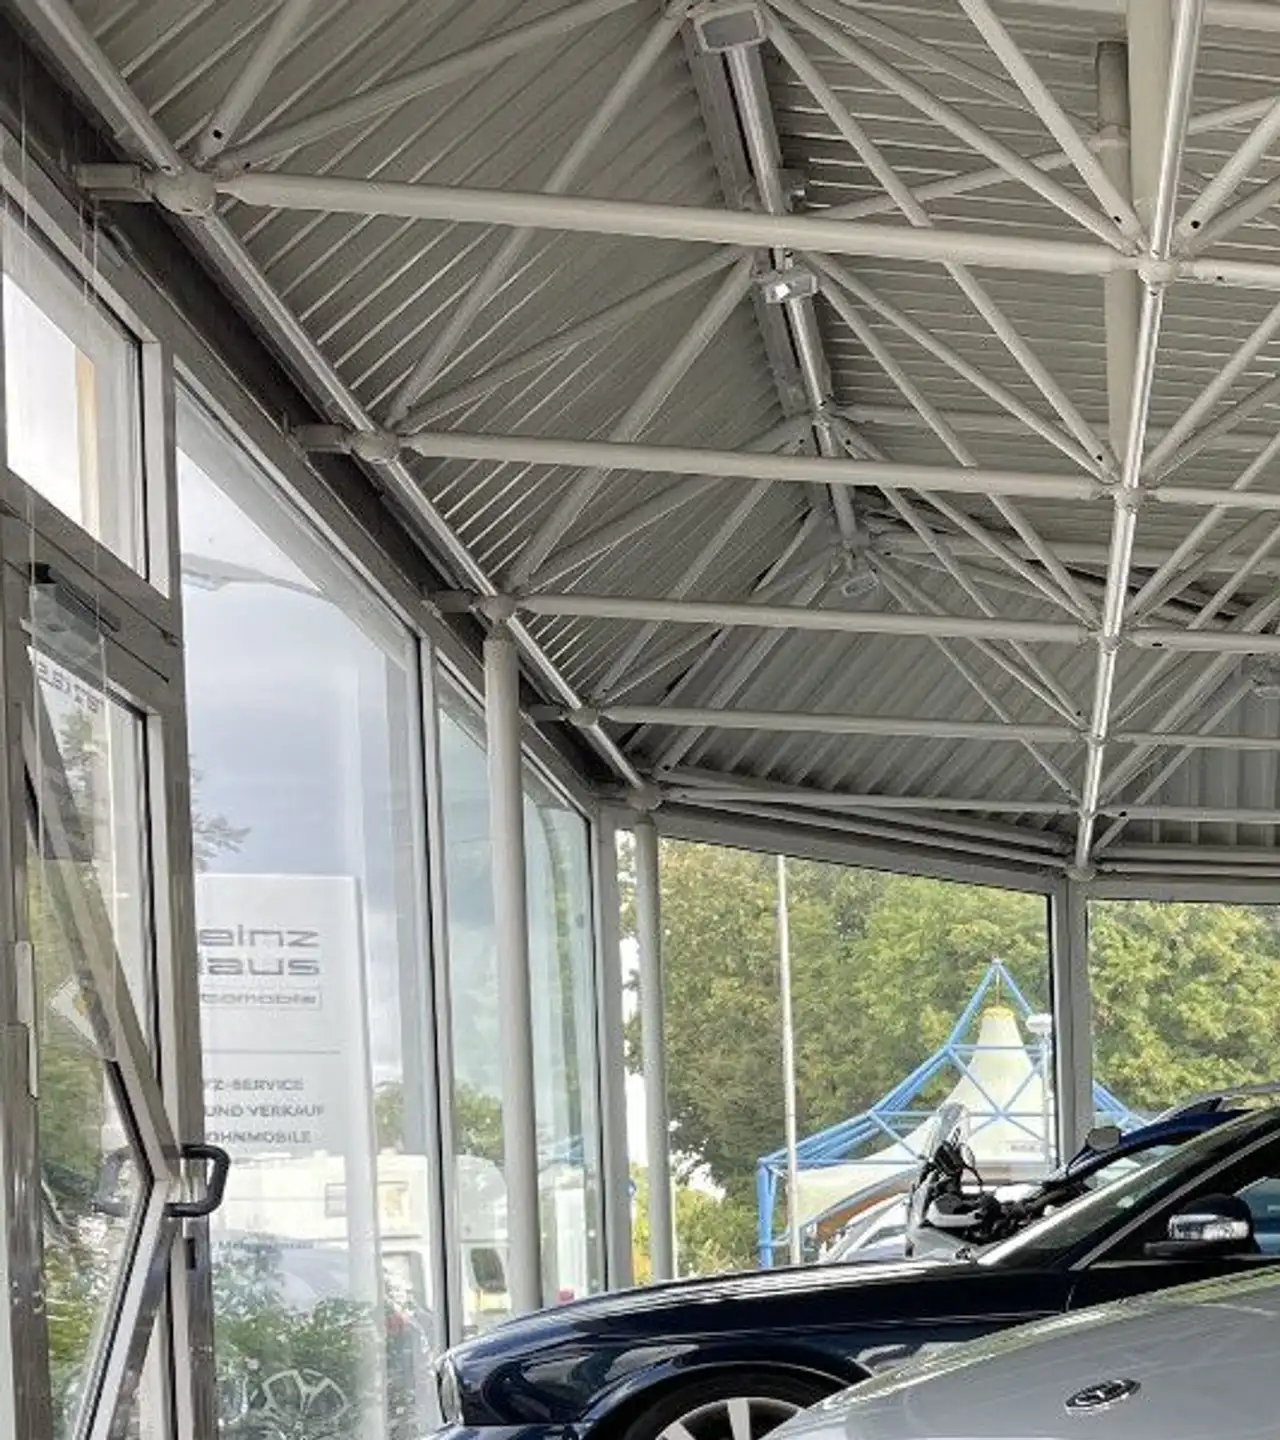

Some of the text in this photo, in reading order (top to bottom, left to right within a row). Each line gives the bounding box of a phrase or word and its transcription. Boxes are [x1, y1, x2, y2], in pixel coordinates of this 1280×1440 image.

[199, 924, 320, 947] einz
[197, 952, 320, 976] laus
[200, 993, 317, 1005] tomobile
[247, 1104, 325, 1118] VERKAUF
[207, 1131, 312, 1144] OHNMOBILE
